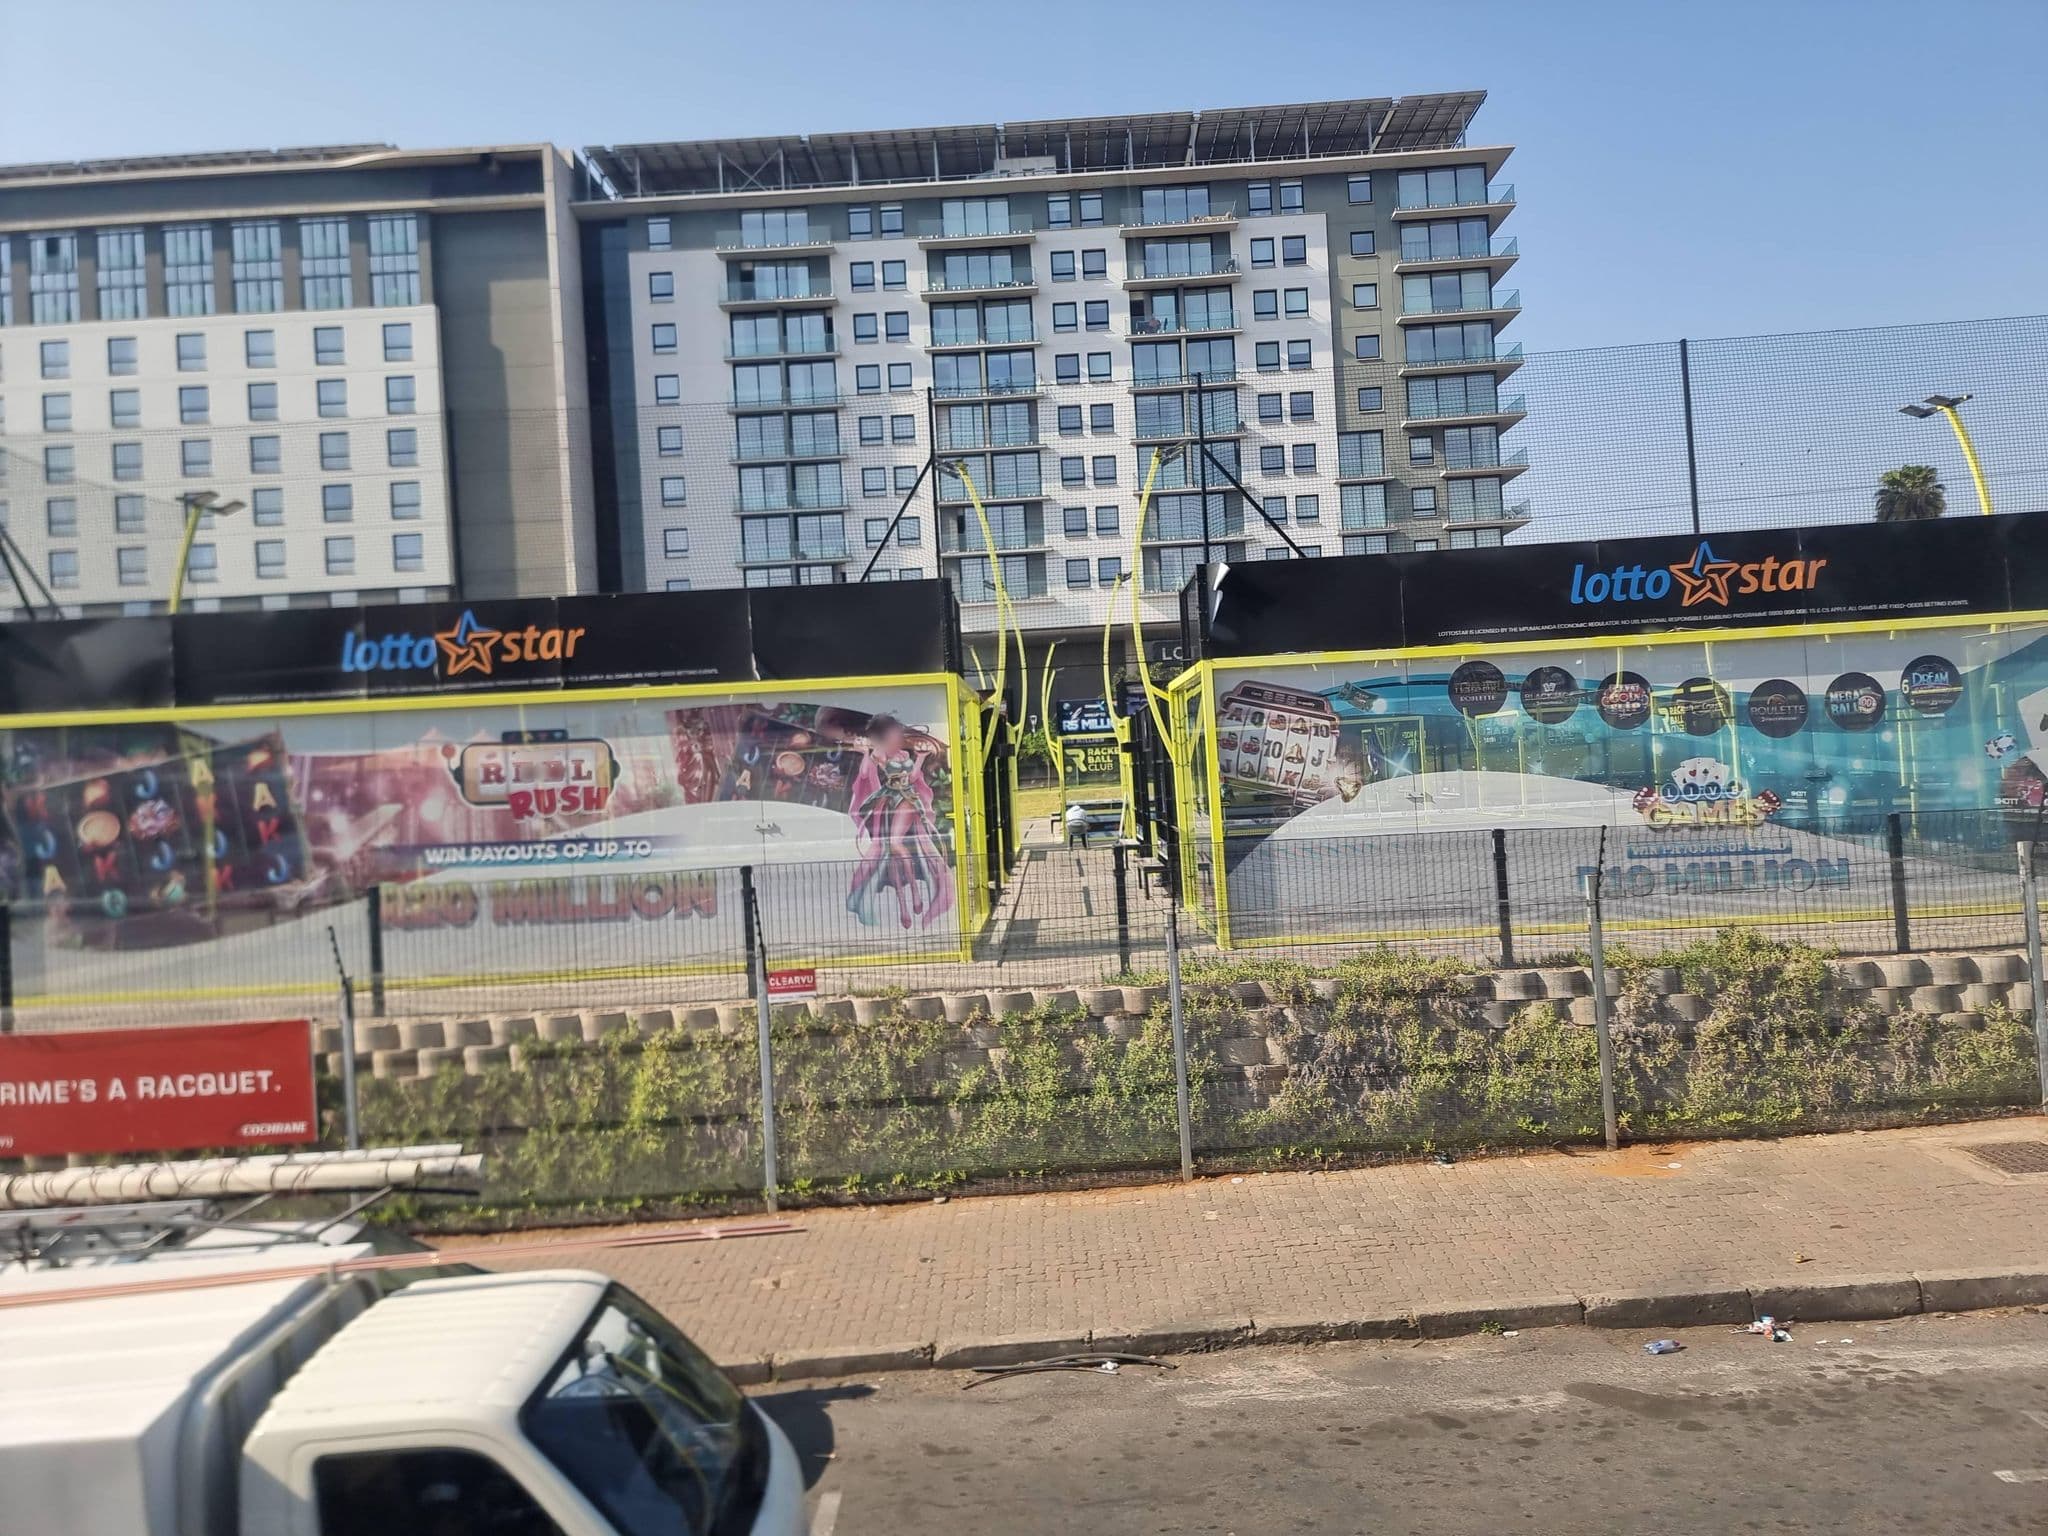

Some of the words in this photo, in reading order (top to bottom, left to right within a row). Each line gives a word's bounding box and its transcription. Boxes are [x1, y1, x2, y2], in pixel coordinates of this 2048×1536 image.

[1570, 564, 1670, 604] lotto
[1738, 555, 1828, 593] star
[1475, 627, 1500, 635] LICENSED
[1703, 613, 1732, 621] GAMBLING
[1733, 611, 1767, 619] PROGRAMME
[341, 631, 437, 673] lotto
[501, 624, 585, 662] star
[1912, 672, 1949, 685] DREAM
[1312, 725, 1330, 738] 10
[1263, 739, 1284, 759] 10
[1087, 755, 1113, 764] BALL
[1087, 763, 1114, 772] CLUB
[1280, 769, 1300, 786] K
[1662, 782, 1743, 801] LIVE
[509, 784, 611, 821] RUSH
[424, 848, 467, 865] WIN
[471, 844, 558, 863] PAYOUTS
[562, 842, 589, 858] OF
[593, 841, 620, 857] UP
[623, 840, 652, 856] TO
[1664, 857, 1850, 897] MILLION
[492, 870, 718, 925] MILLION
[768, 975, 814, 987] CLEARVU
[107, 1077, 127, 1101] A
[137, 1069, 283, 1100] RACQUET.
[241, 1121, 308, 1138] COCHRANE
